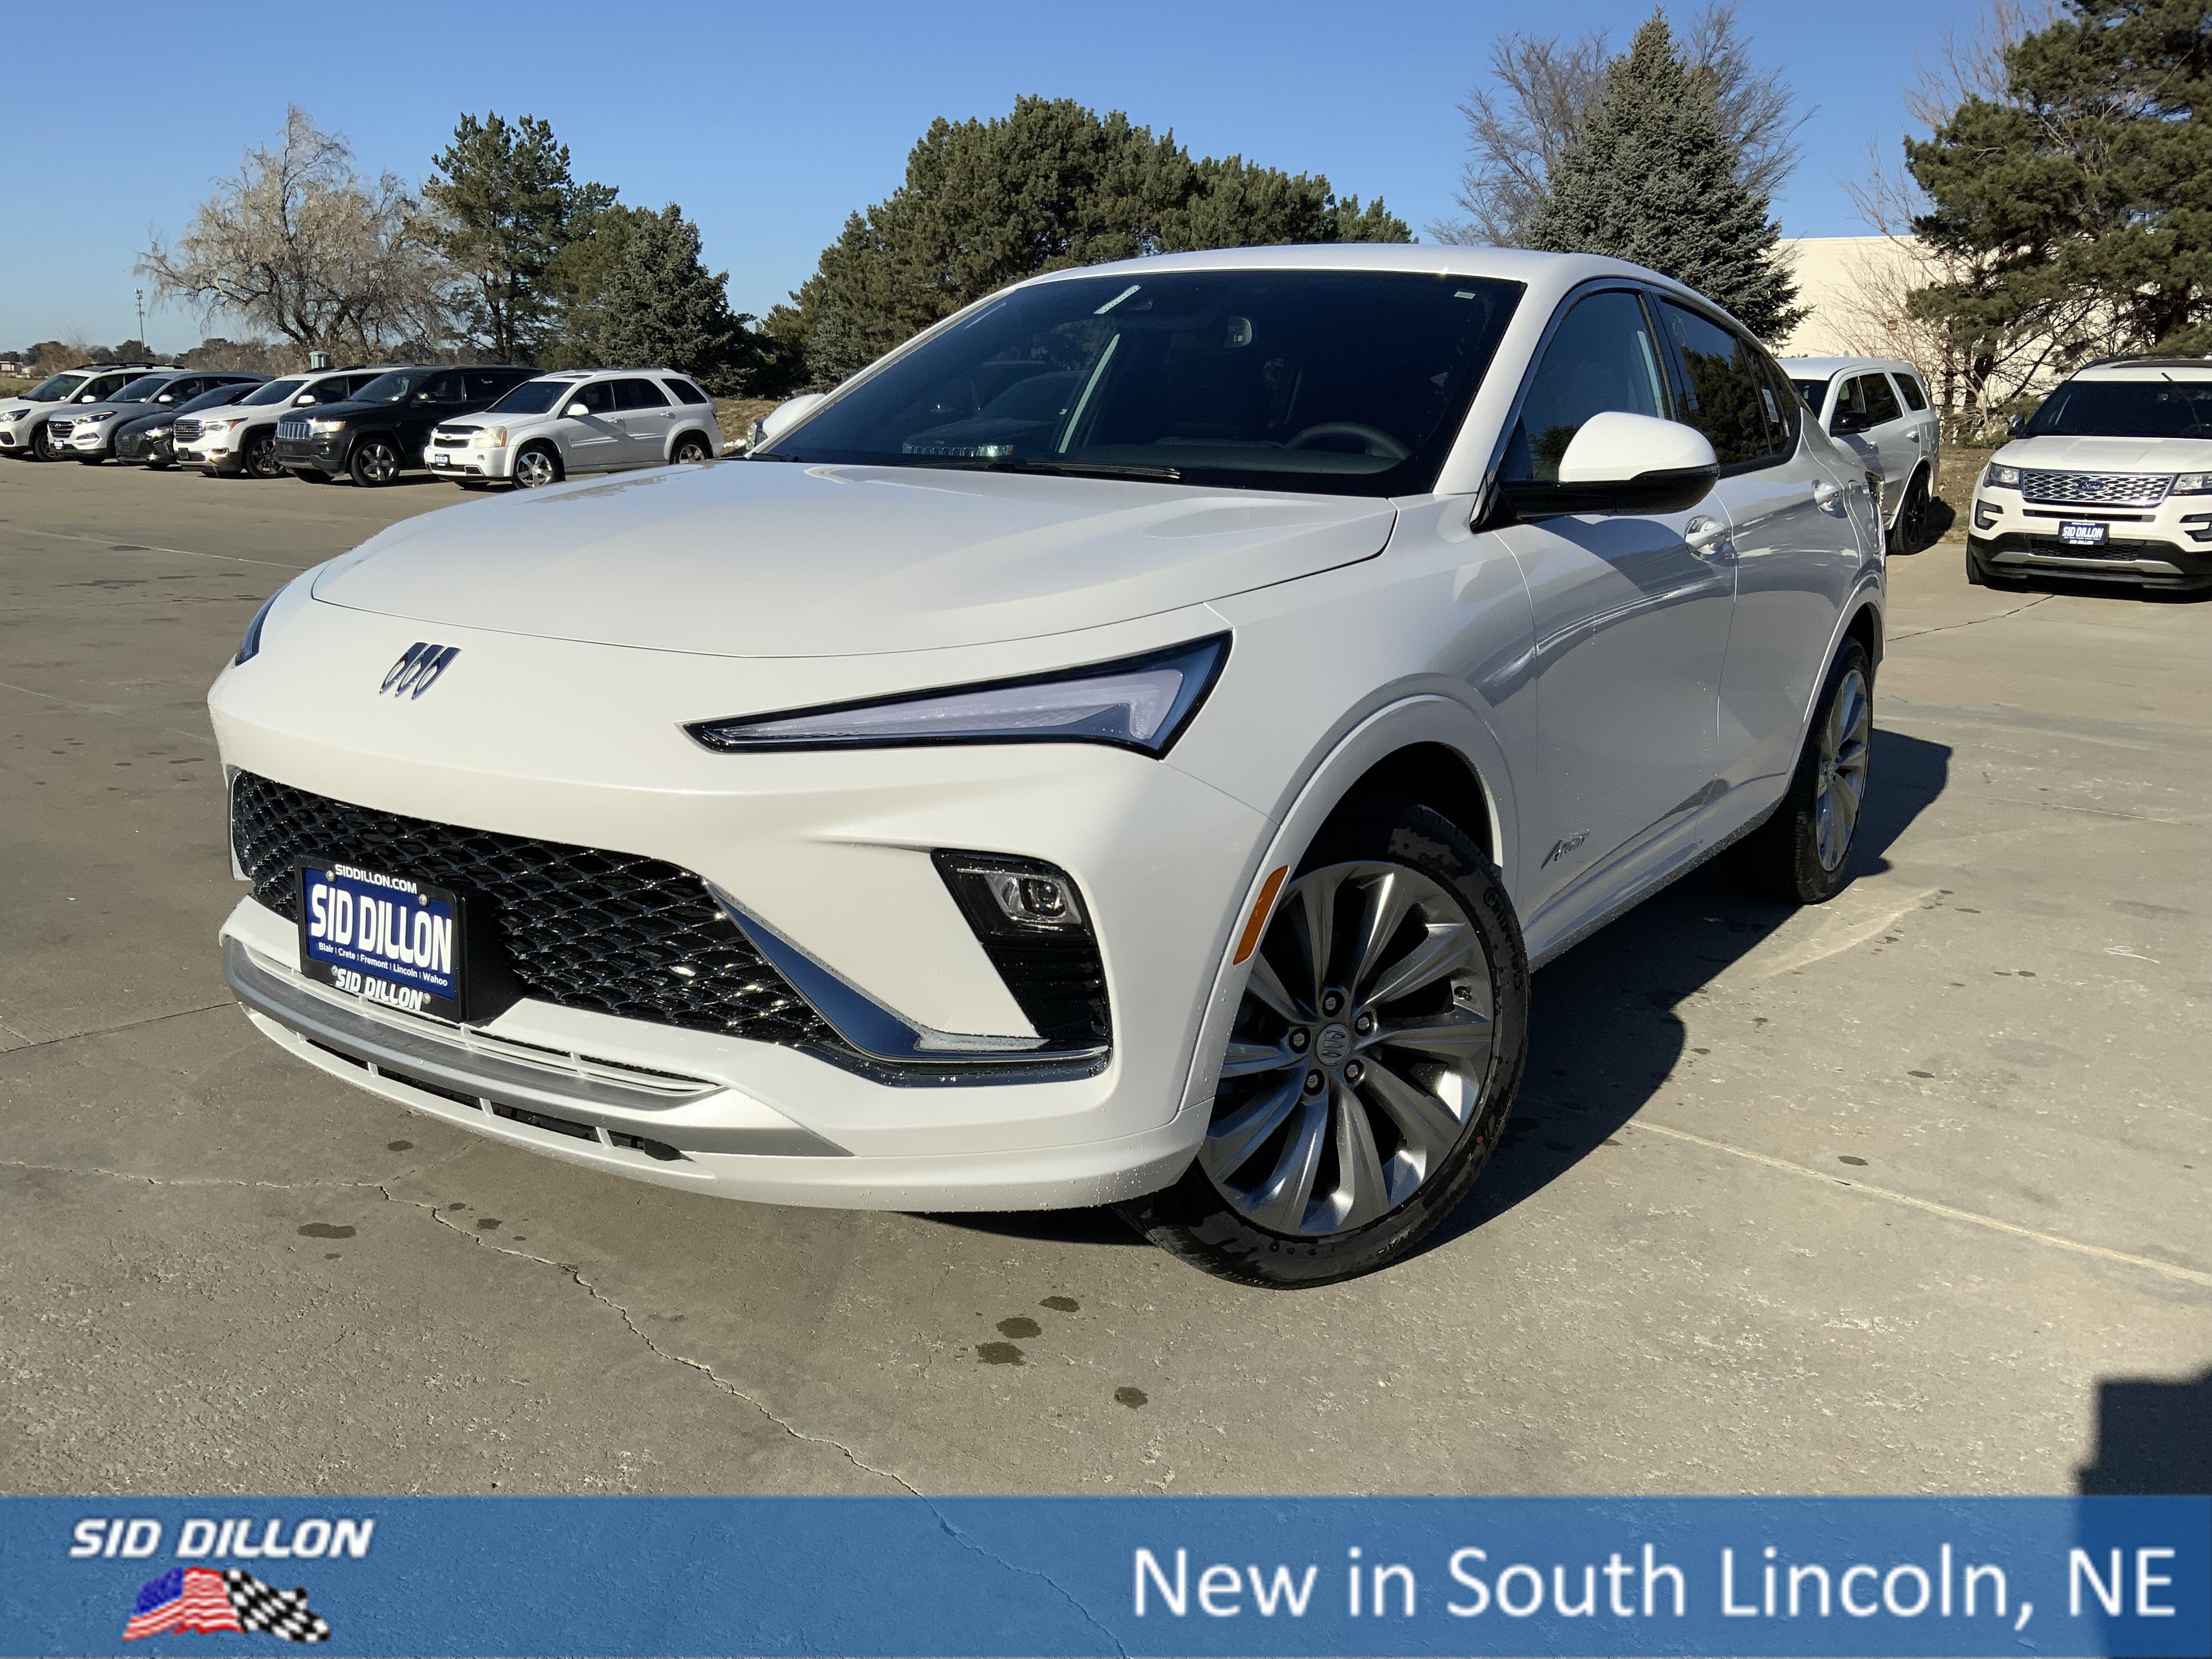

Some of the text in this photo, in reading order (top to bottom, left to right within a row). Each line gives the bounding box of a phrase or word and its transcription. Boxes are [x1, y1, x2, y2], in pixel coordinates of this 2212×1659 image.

[2062, 526, 2104, 538] SID DILLON
[335, 864, 417, 895] SIDDILLON.COM
[311, 884, 452, 974] SID DILLON
[318, 942, 448, 987] Blair Crete Fremont Lincoln Wahoo
[335, 968, 424, 1011] SID DILLON
